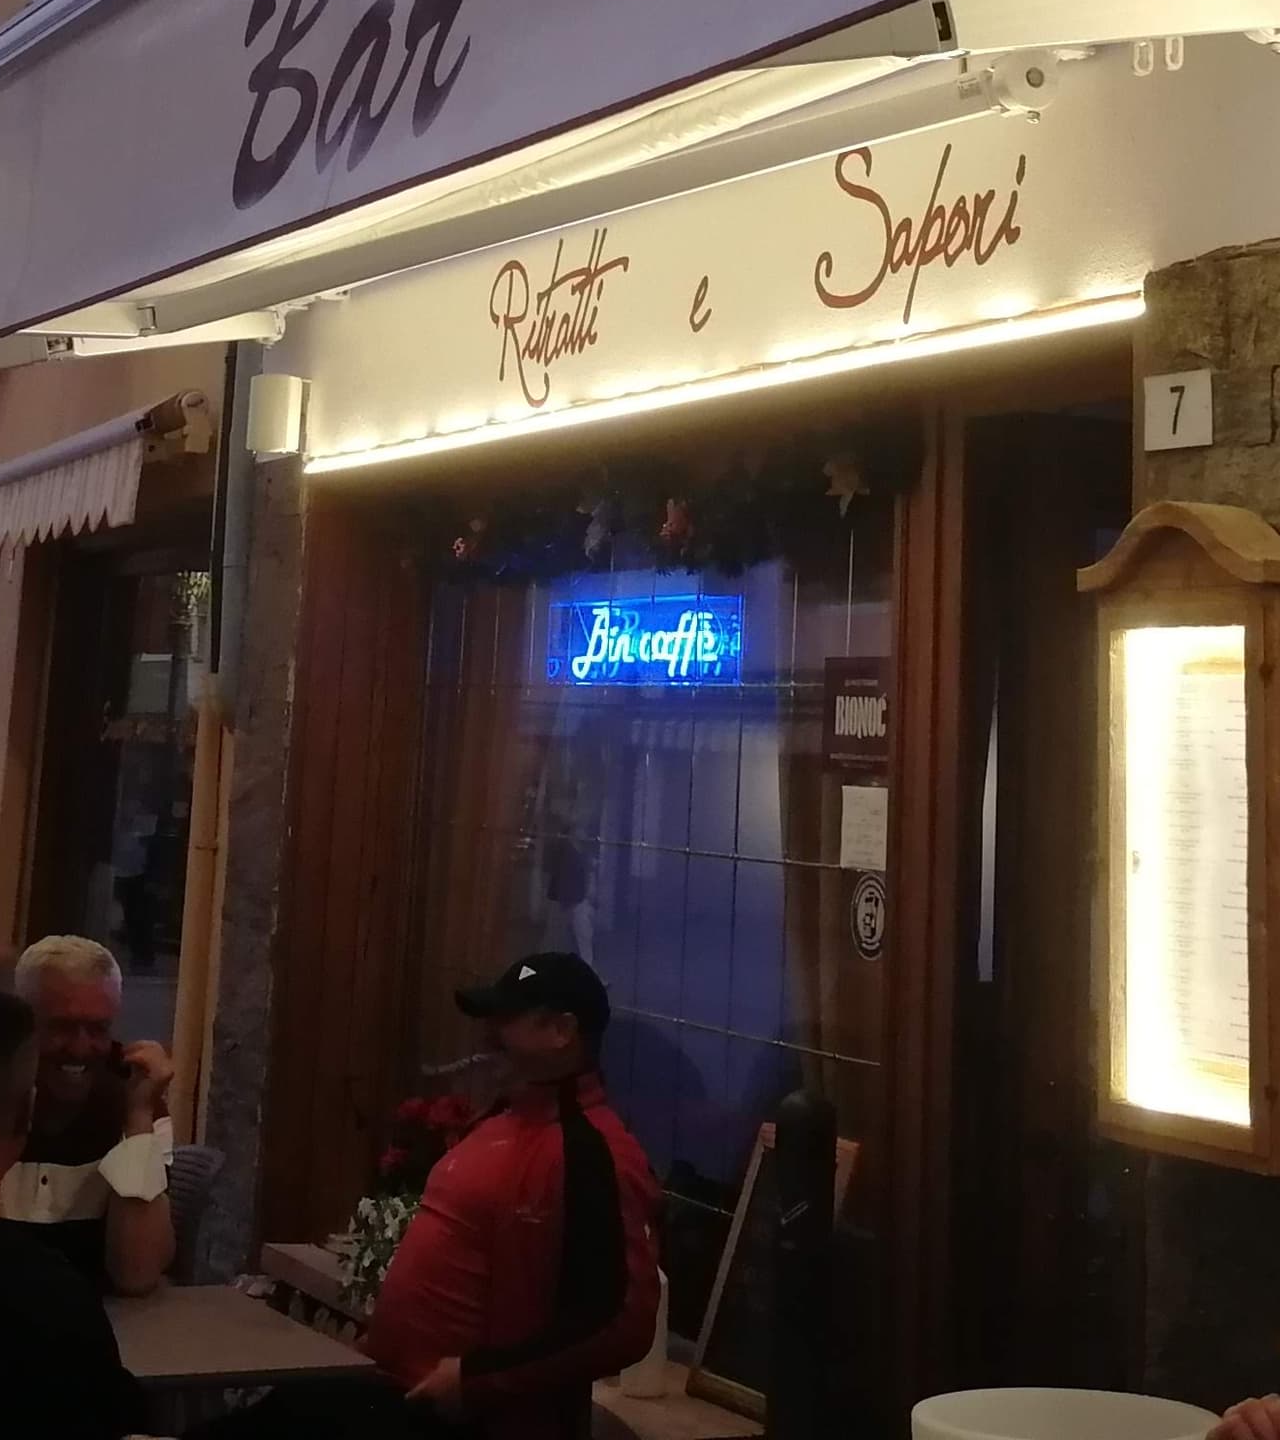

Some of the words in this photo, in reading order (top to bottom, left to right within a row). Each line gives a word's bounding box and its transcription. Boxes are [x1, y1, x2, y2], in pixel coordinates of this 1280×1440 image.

[489, 227, 630, 408] Ritratti
[688, 275, 712, 333] e
[814, 143, 1027, 325] Sapori
[1169, 385, 1186, 436] 7
